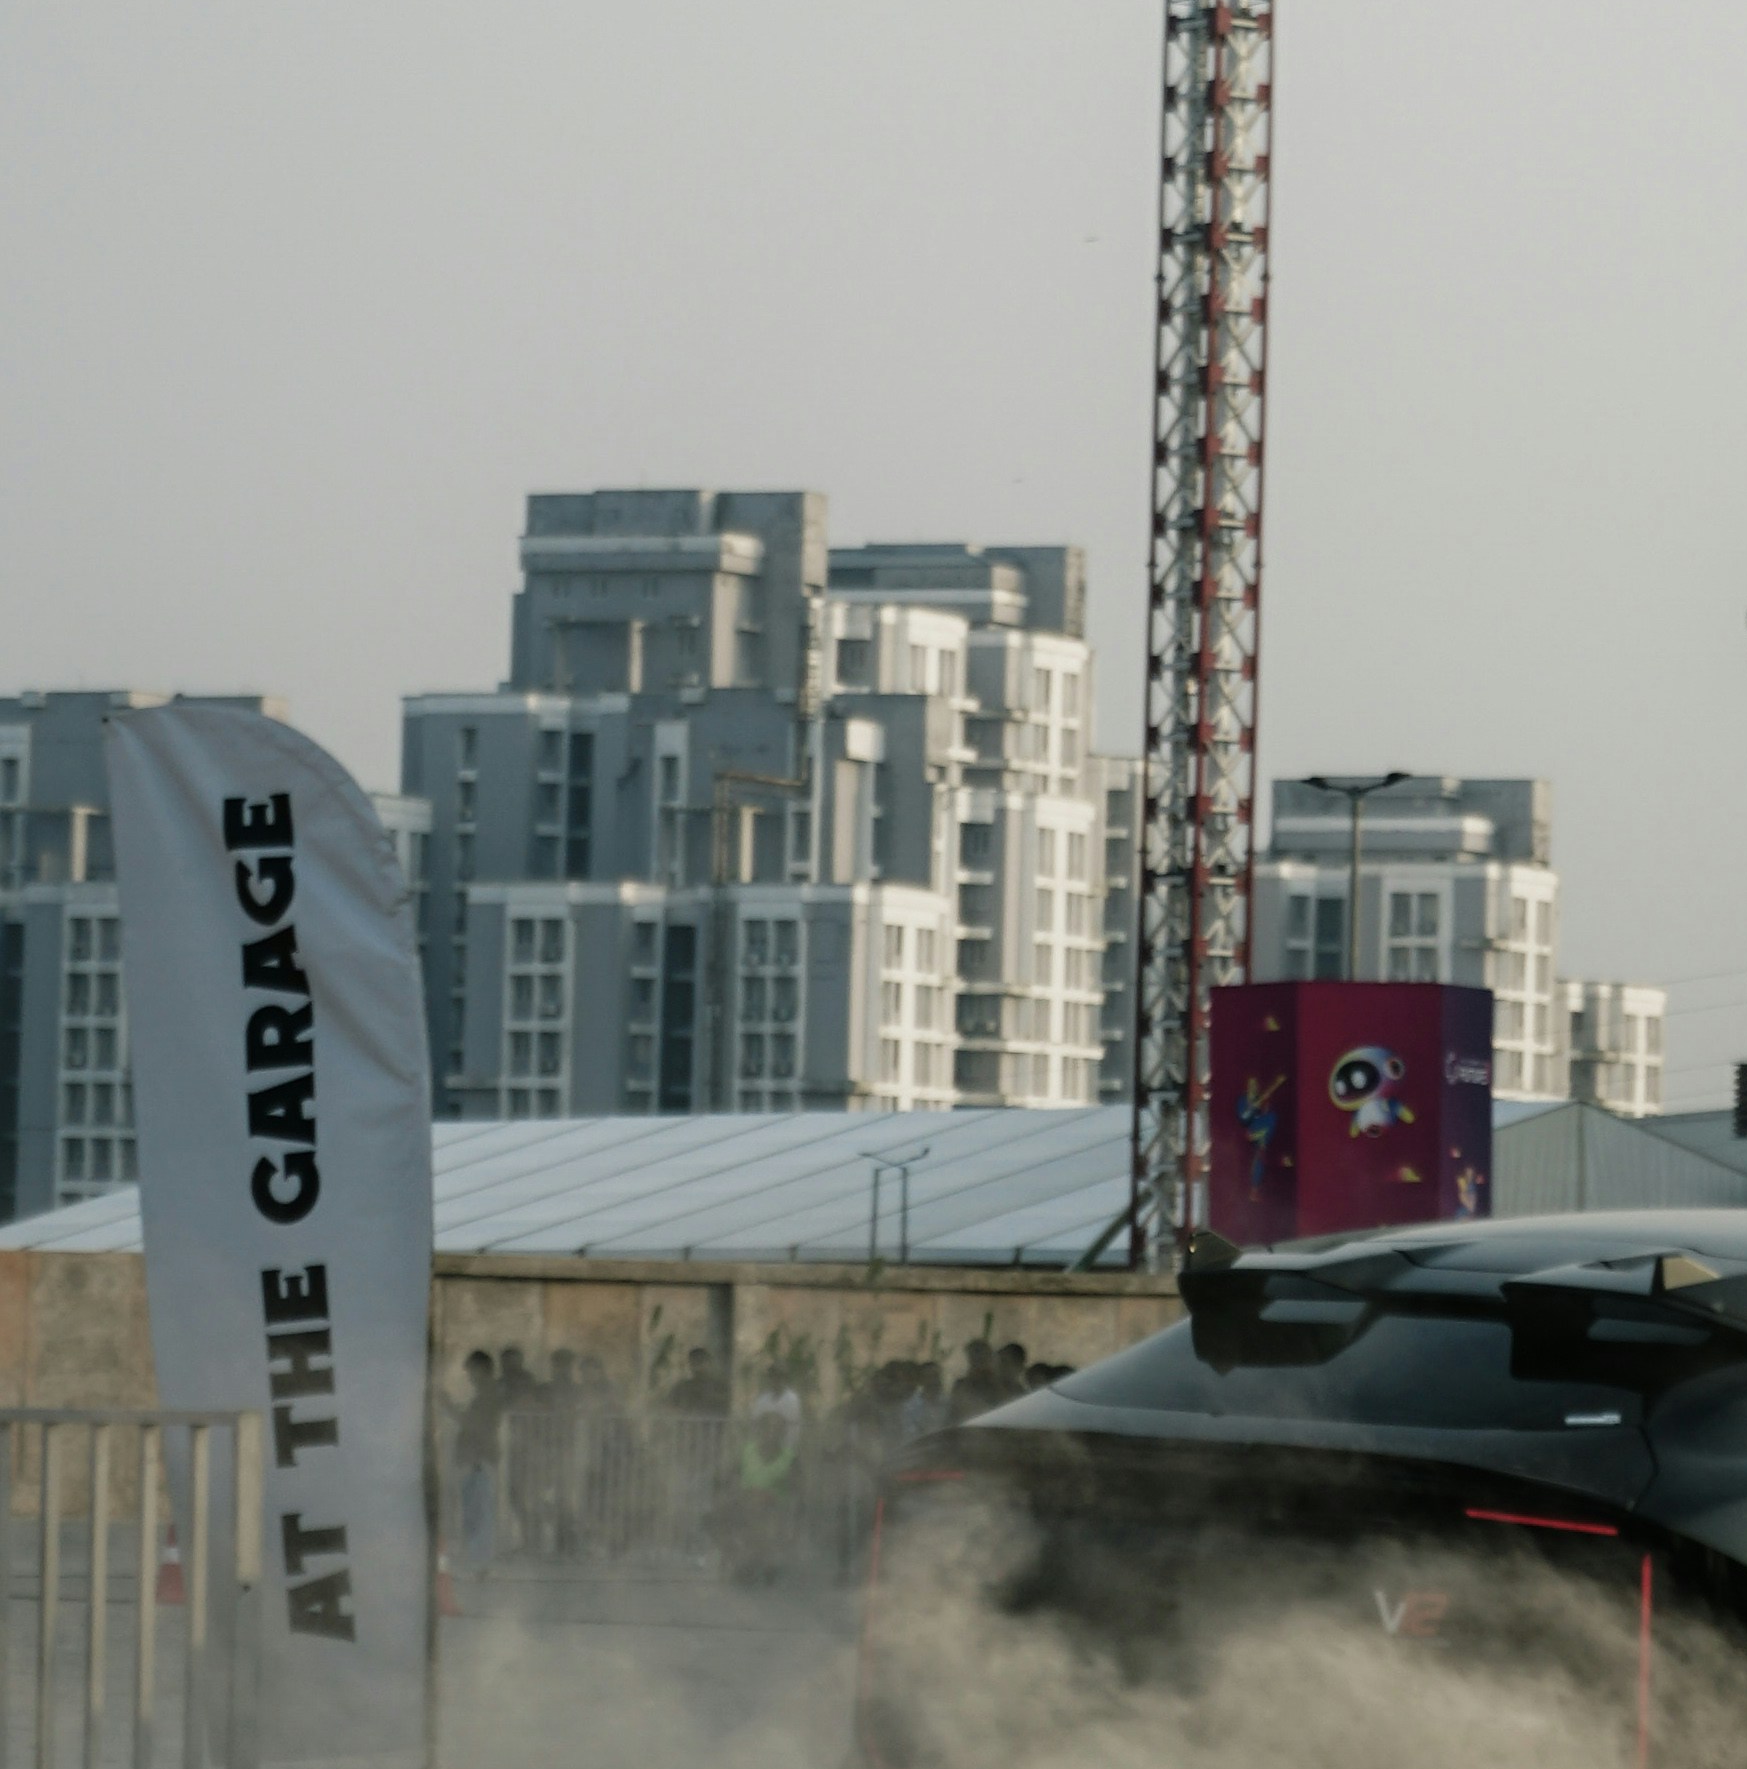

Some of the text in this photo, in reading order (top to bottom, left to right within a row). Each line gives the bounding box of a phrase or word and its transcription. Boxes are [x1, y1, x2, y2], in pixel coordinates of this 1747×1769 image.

[223, 793, 356, 1643] AT THE GARAGE
